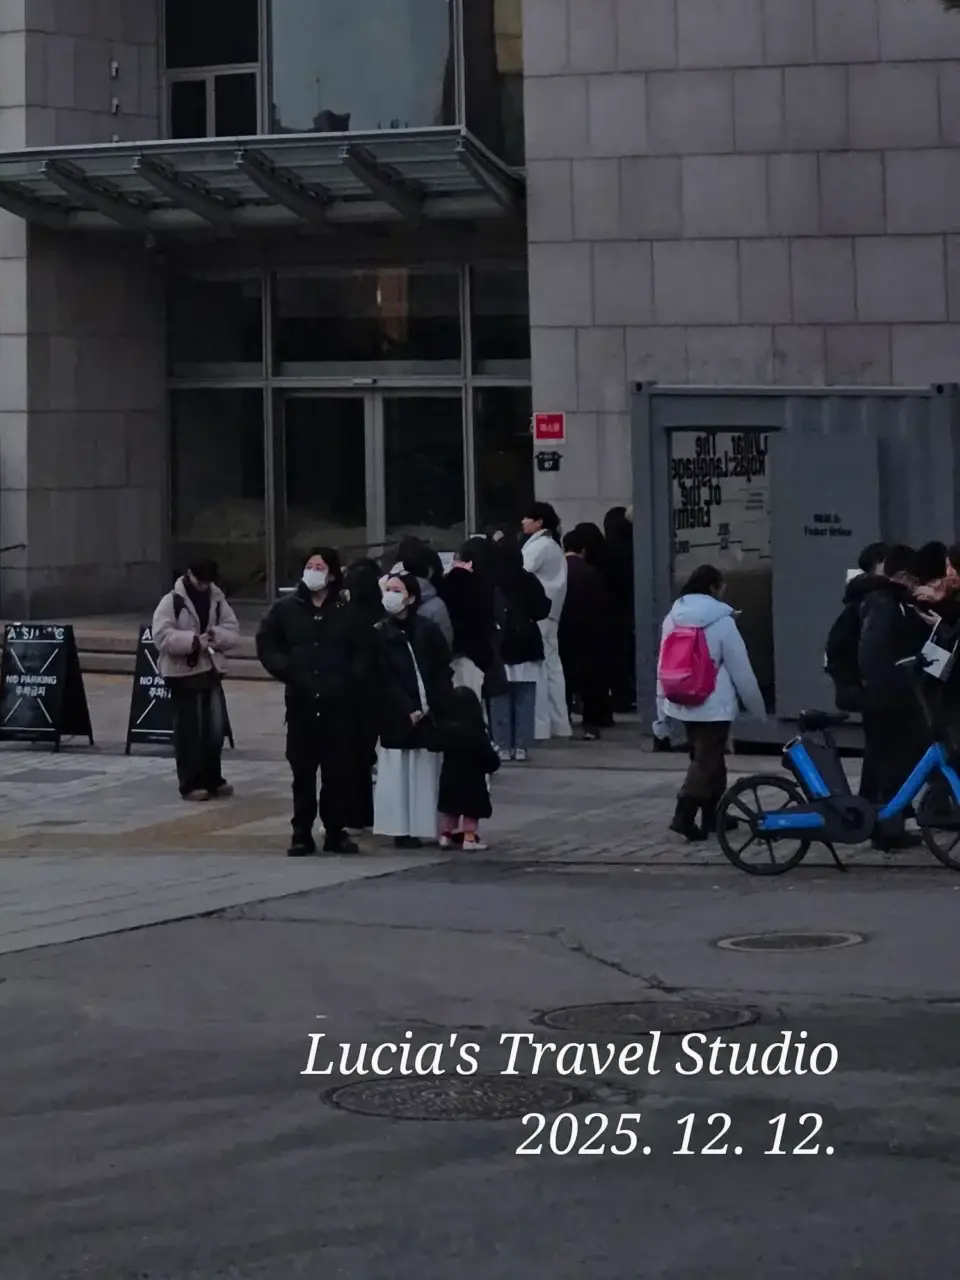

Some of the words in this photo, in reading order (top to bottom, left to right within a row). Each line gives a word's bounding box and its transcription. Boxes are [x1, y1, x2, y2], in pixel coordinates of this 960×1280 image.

[5, 674, 19, 684] NO
[20, 674, 58, 685] PARKING
[139, 676, 153, 685] NO
